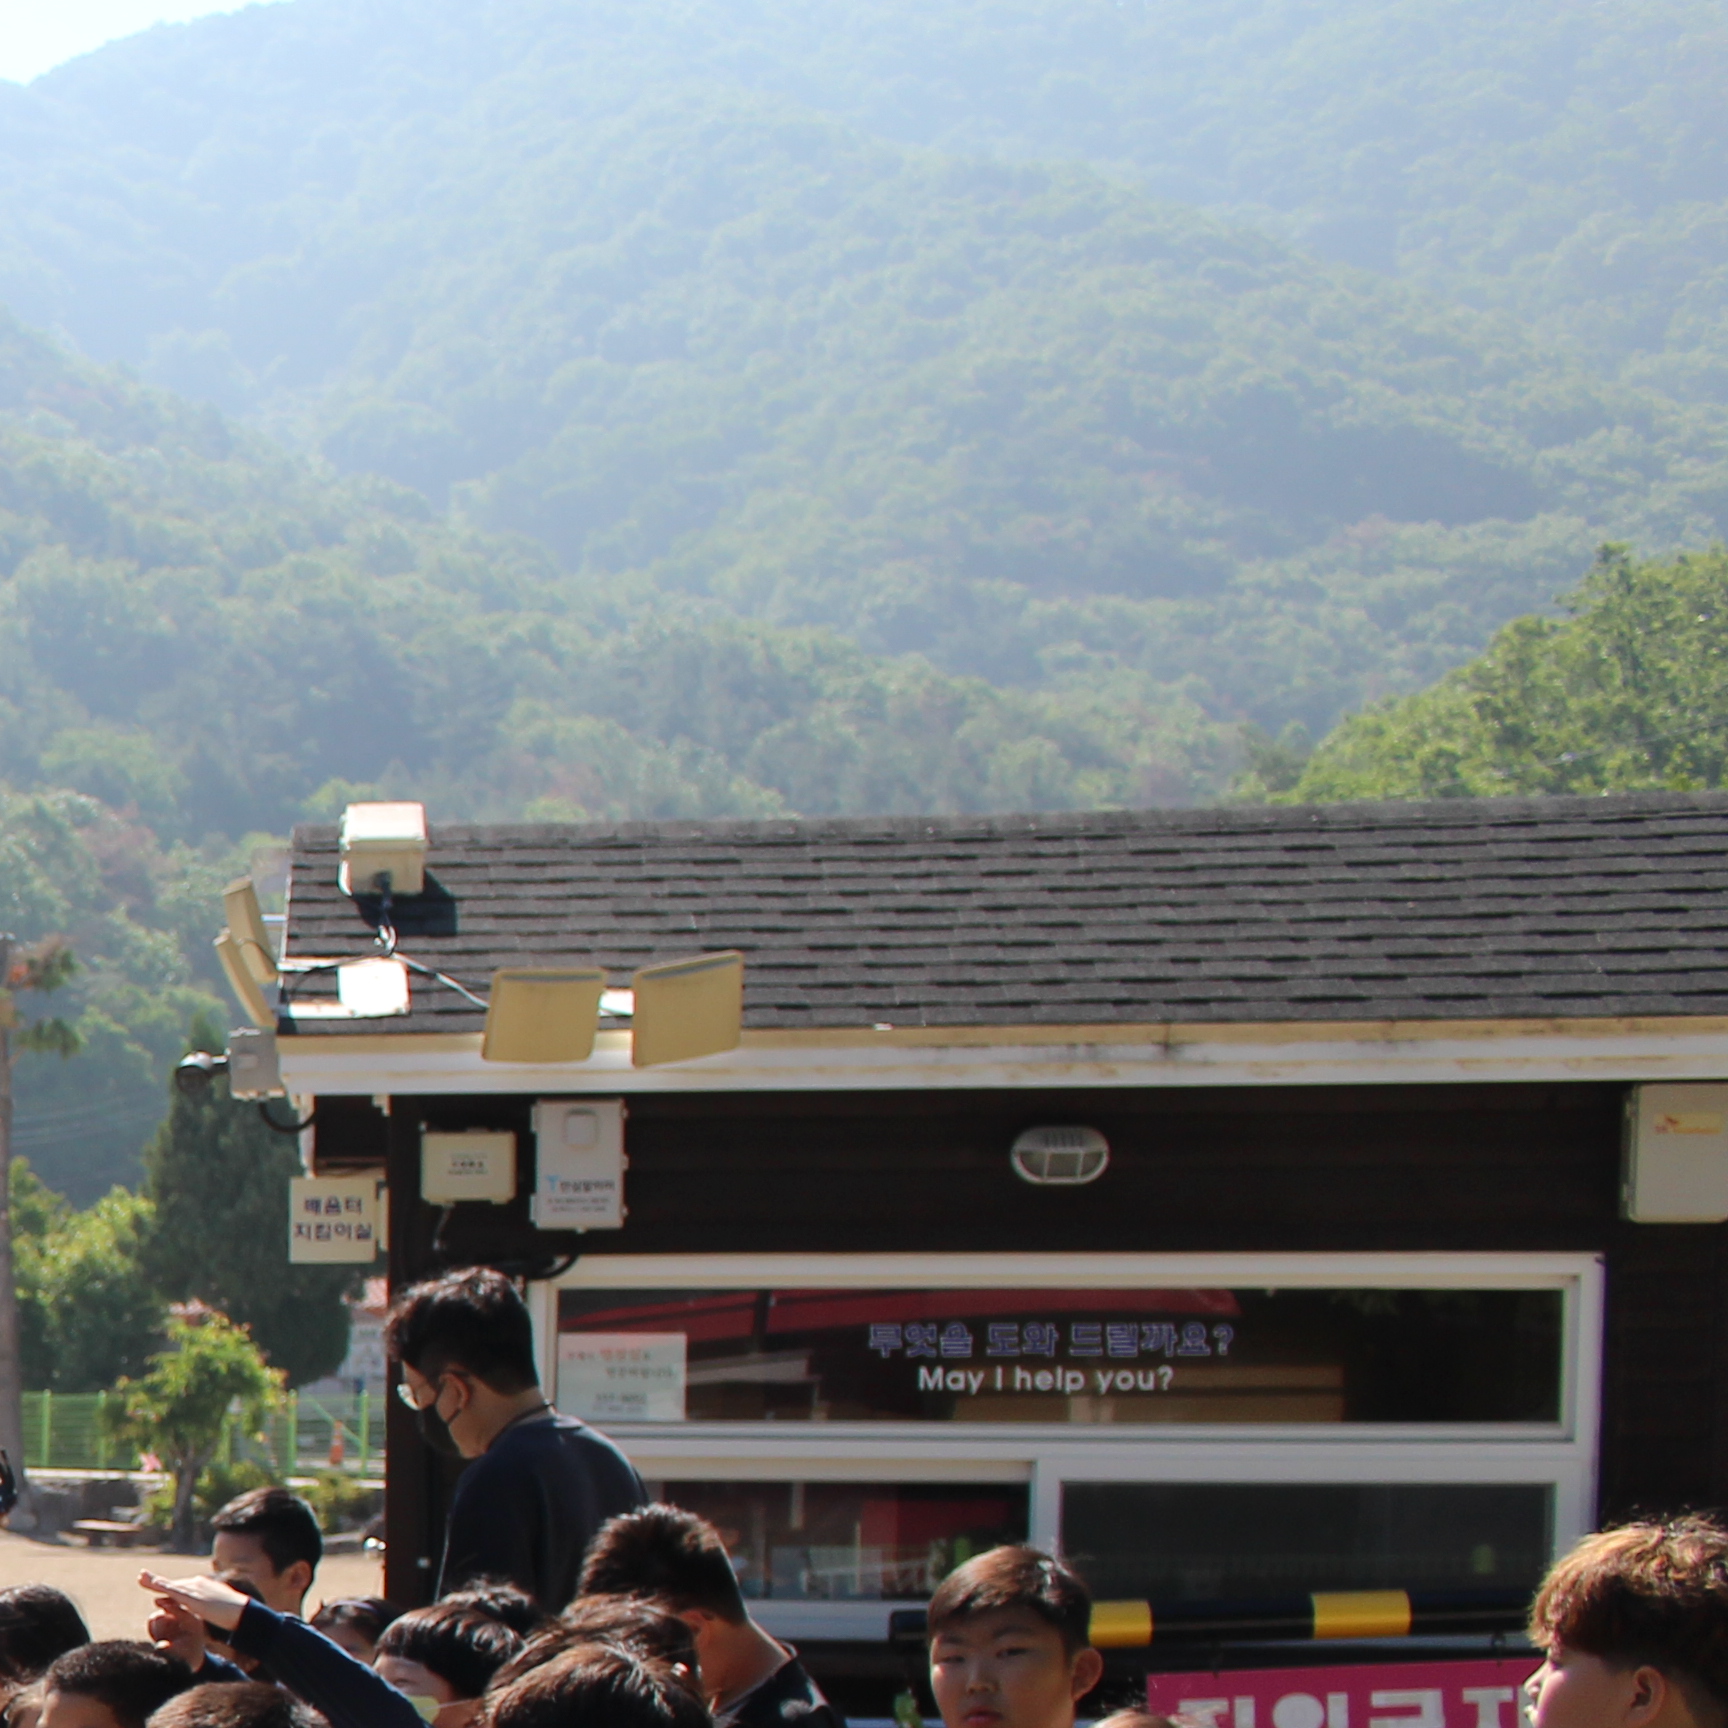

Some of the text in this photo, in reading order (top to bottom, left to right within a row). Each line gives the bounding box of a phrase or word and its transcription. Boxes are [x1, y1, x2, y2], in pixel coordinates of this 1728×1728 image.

[304, 1194, 362, 1215] 배움터
[294, 1221, 372, 1241] 지킴이실
[869, 1322, 1234, 1358] 무엇을 도와 드릴까요?
[918, 1365, 1175, 1396] May I help you?
